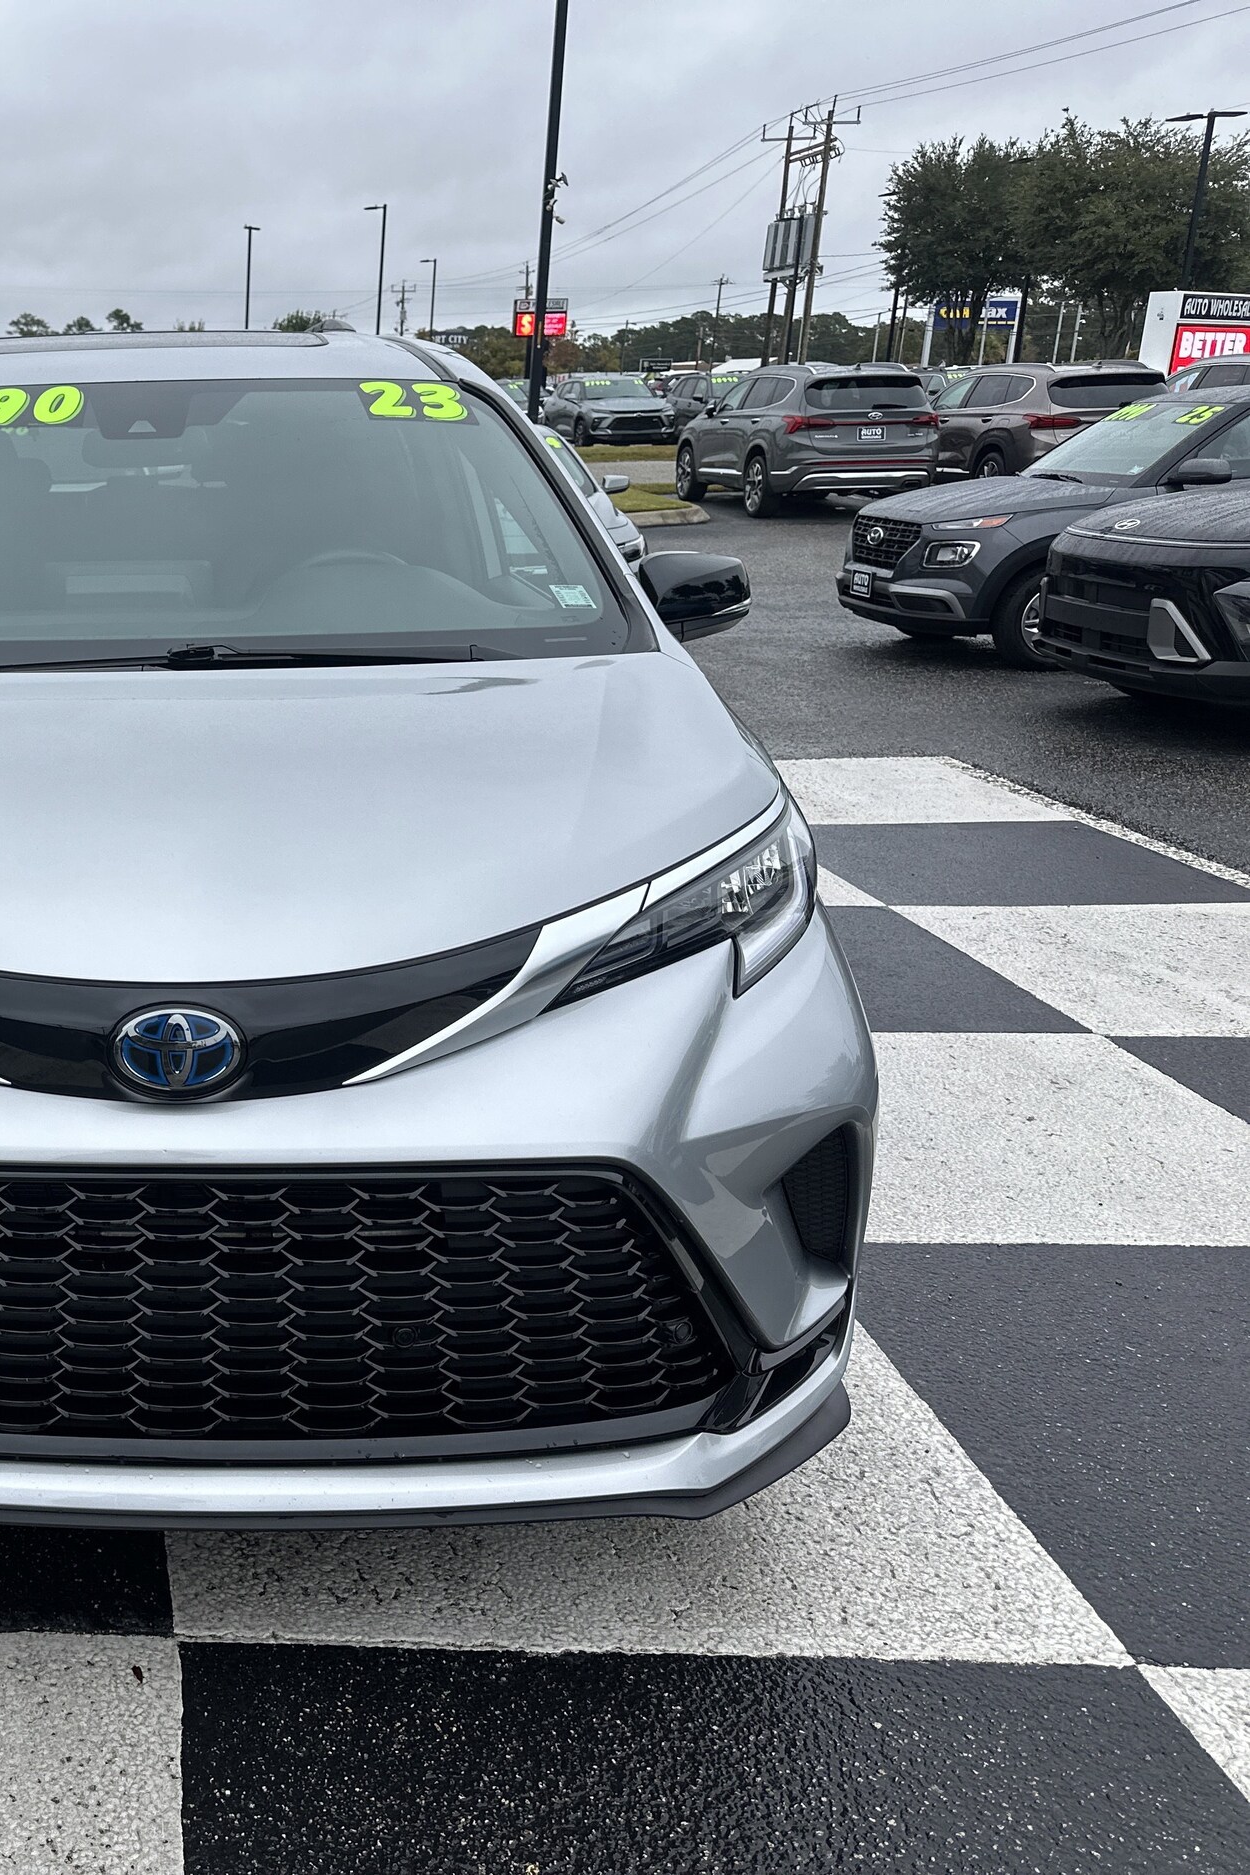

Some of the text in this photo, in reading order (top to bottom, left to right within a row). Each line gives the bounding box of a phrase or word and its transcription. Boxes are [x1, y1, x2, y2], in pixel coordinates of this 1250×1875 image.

[1184, 298, 1209, 315] AUTO
[448, 334, 469, 345] CITY
[1178, 331, 1247, 358] BETTER
[359, 381, 468, 421] 23
[1175, 405, 1225, 425] 25
[860, 427, 882, 436] AUTO
[853, 572, 869, 586] AUTO
